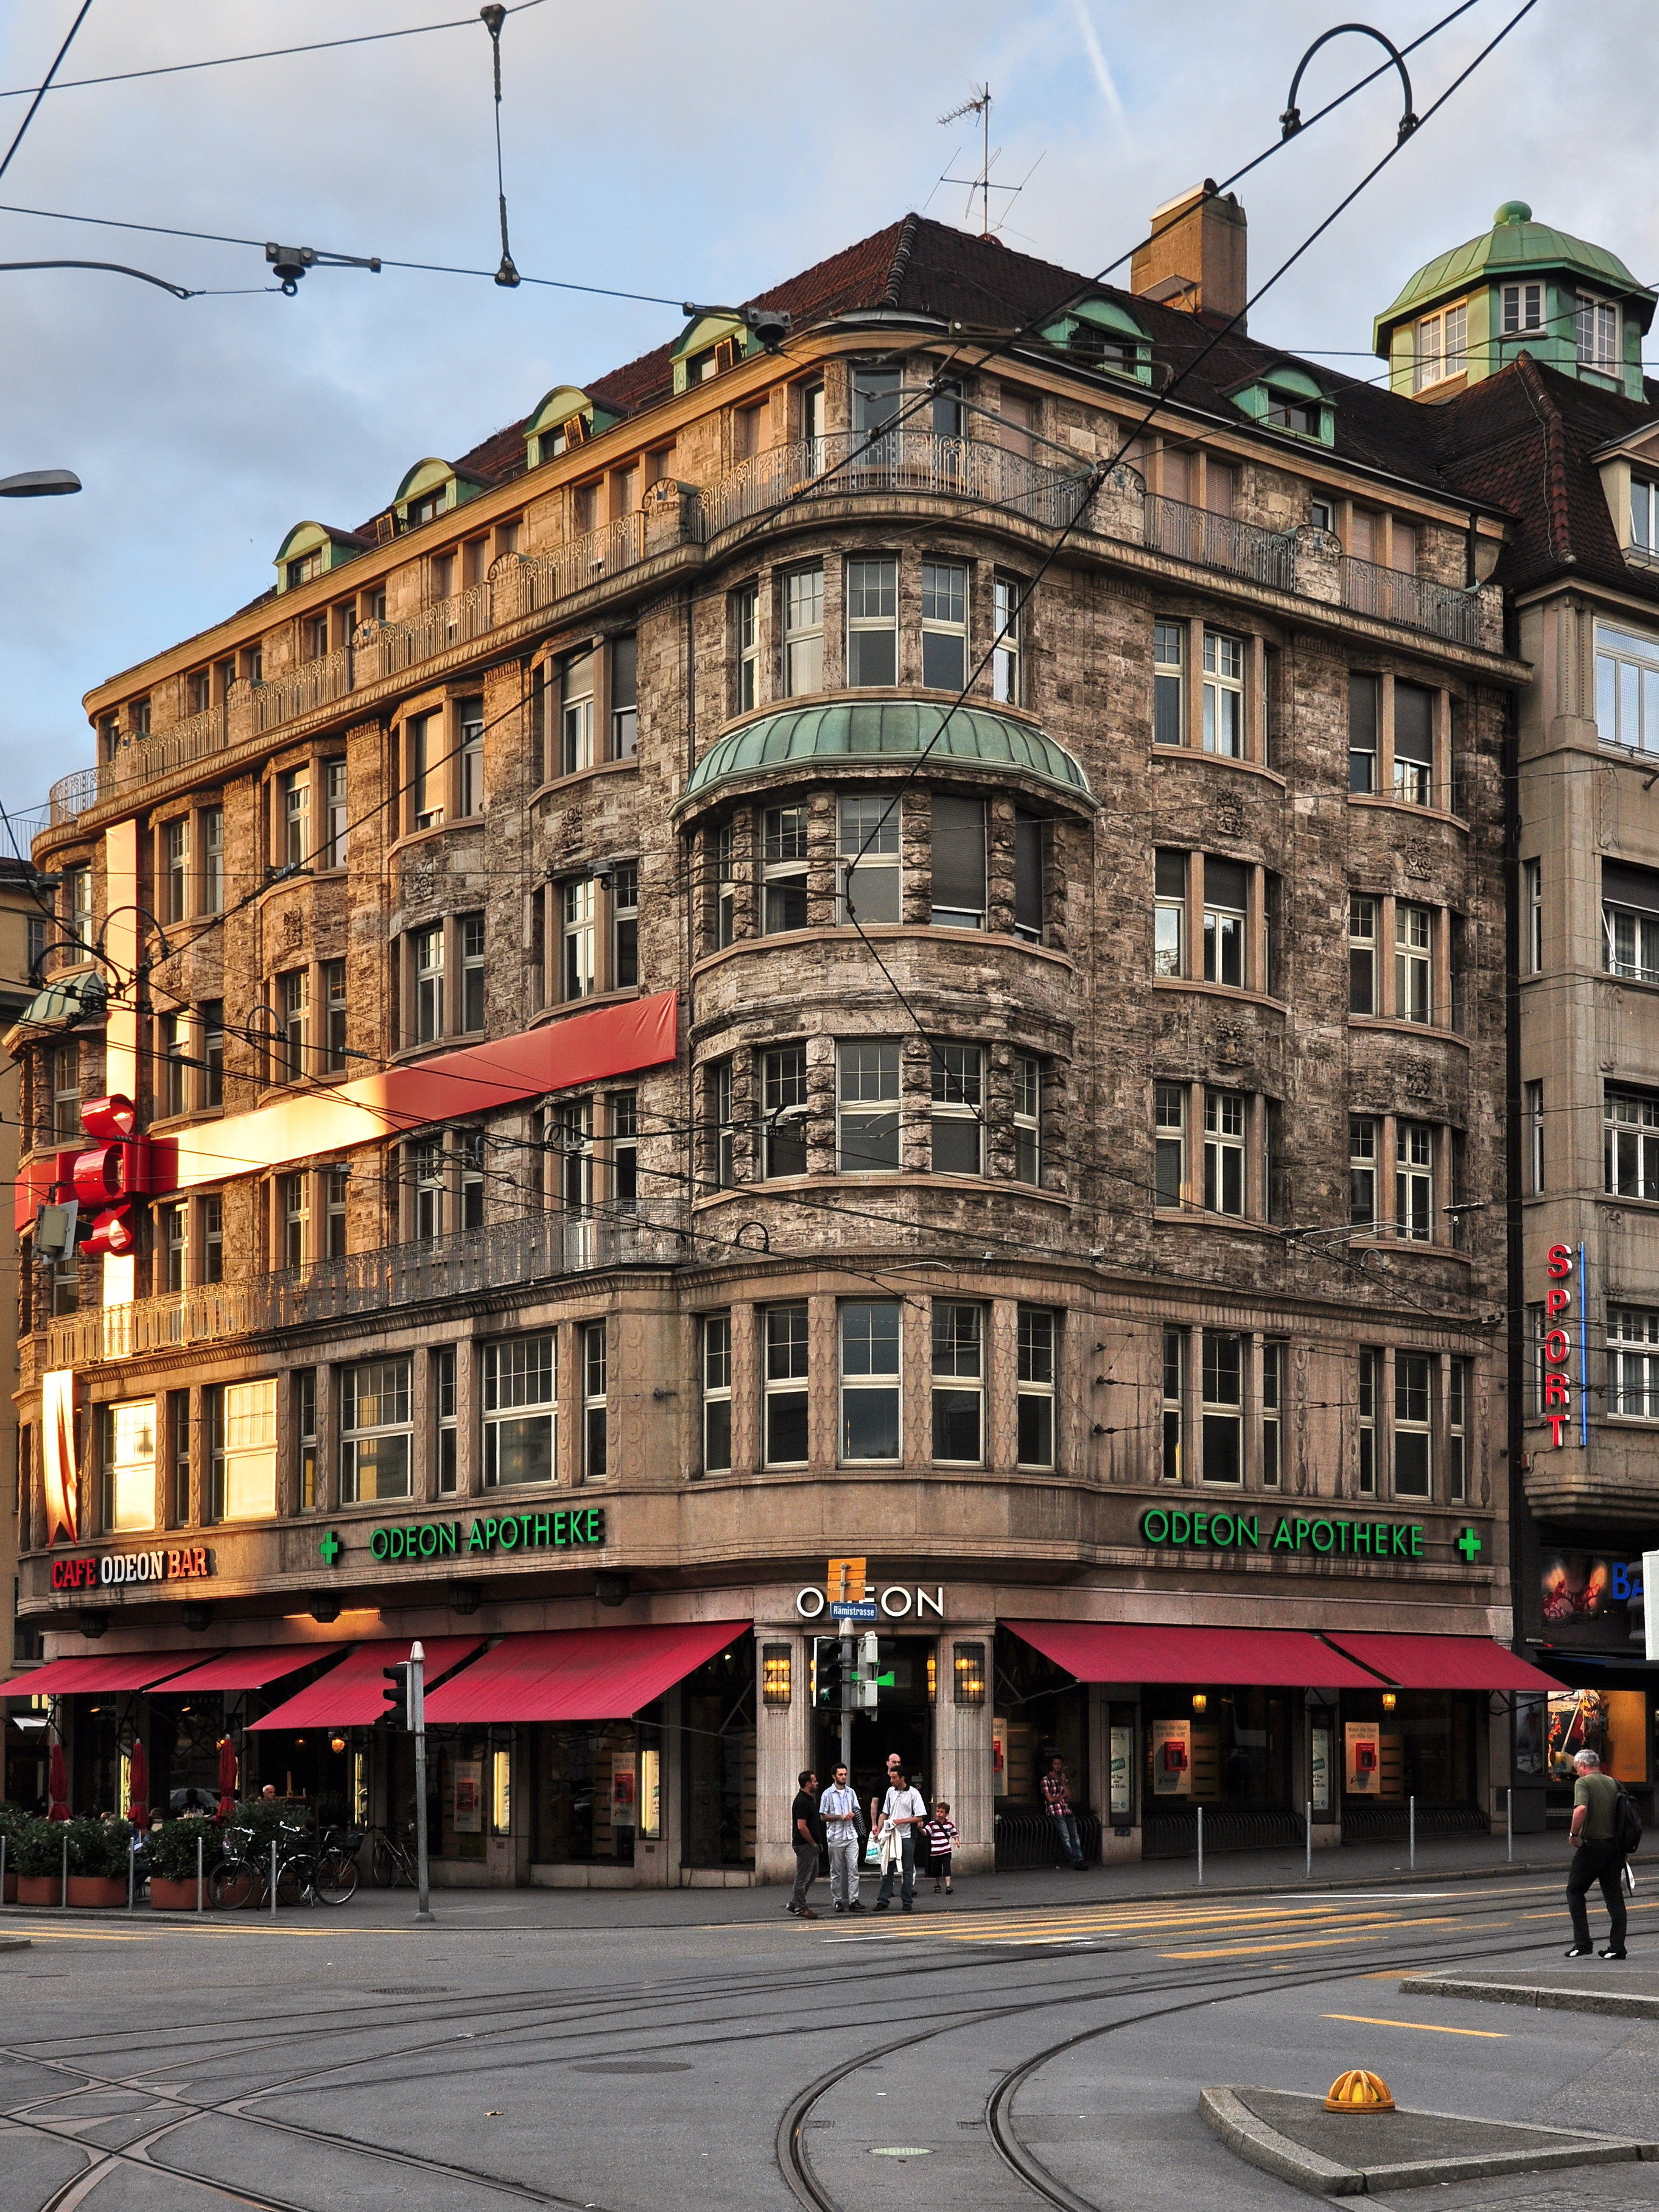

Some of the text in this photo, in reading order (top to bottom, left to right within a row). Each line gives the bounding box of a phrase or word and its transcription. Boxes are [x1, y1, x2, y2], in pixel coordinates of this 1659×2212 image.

[1545, 1243, 1572, 1447] SPORT
[370, 1508, 600, 1560] ODEON APOTHEKE
[1144, 1509, 1424, 1556] ODEON APOTHEKE
[52, 1547, 208, 1588] CAFE ODEON BAR
[796, 1586, 943, 1618] OEON
[833, 1605, 874, 1617] Rämistrasse
